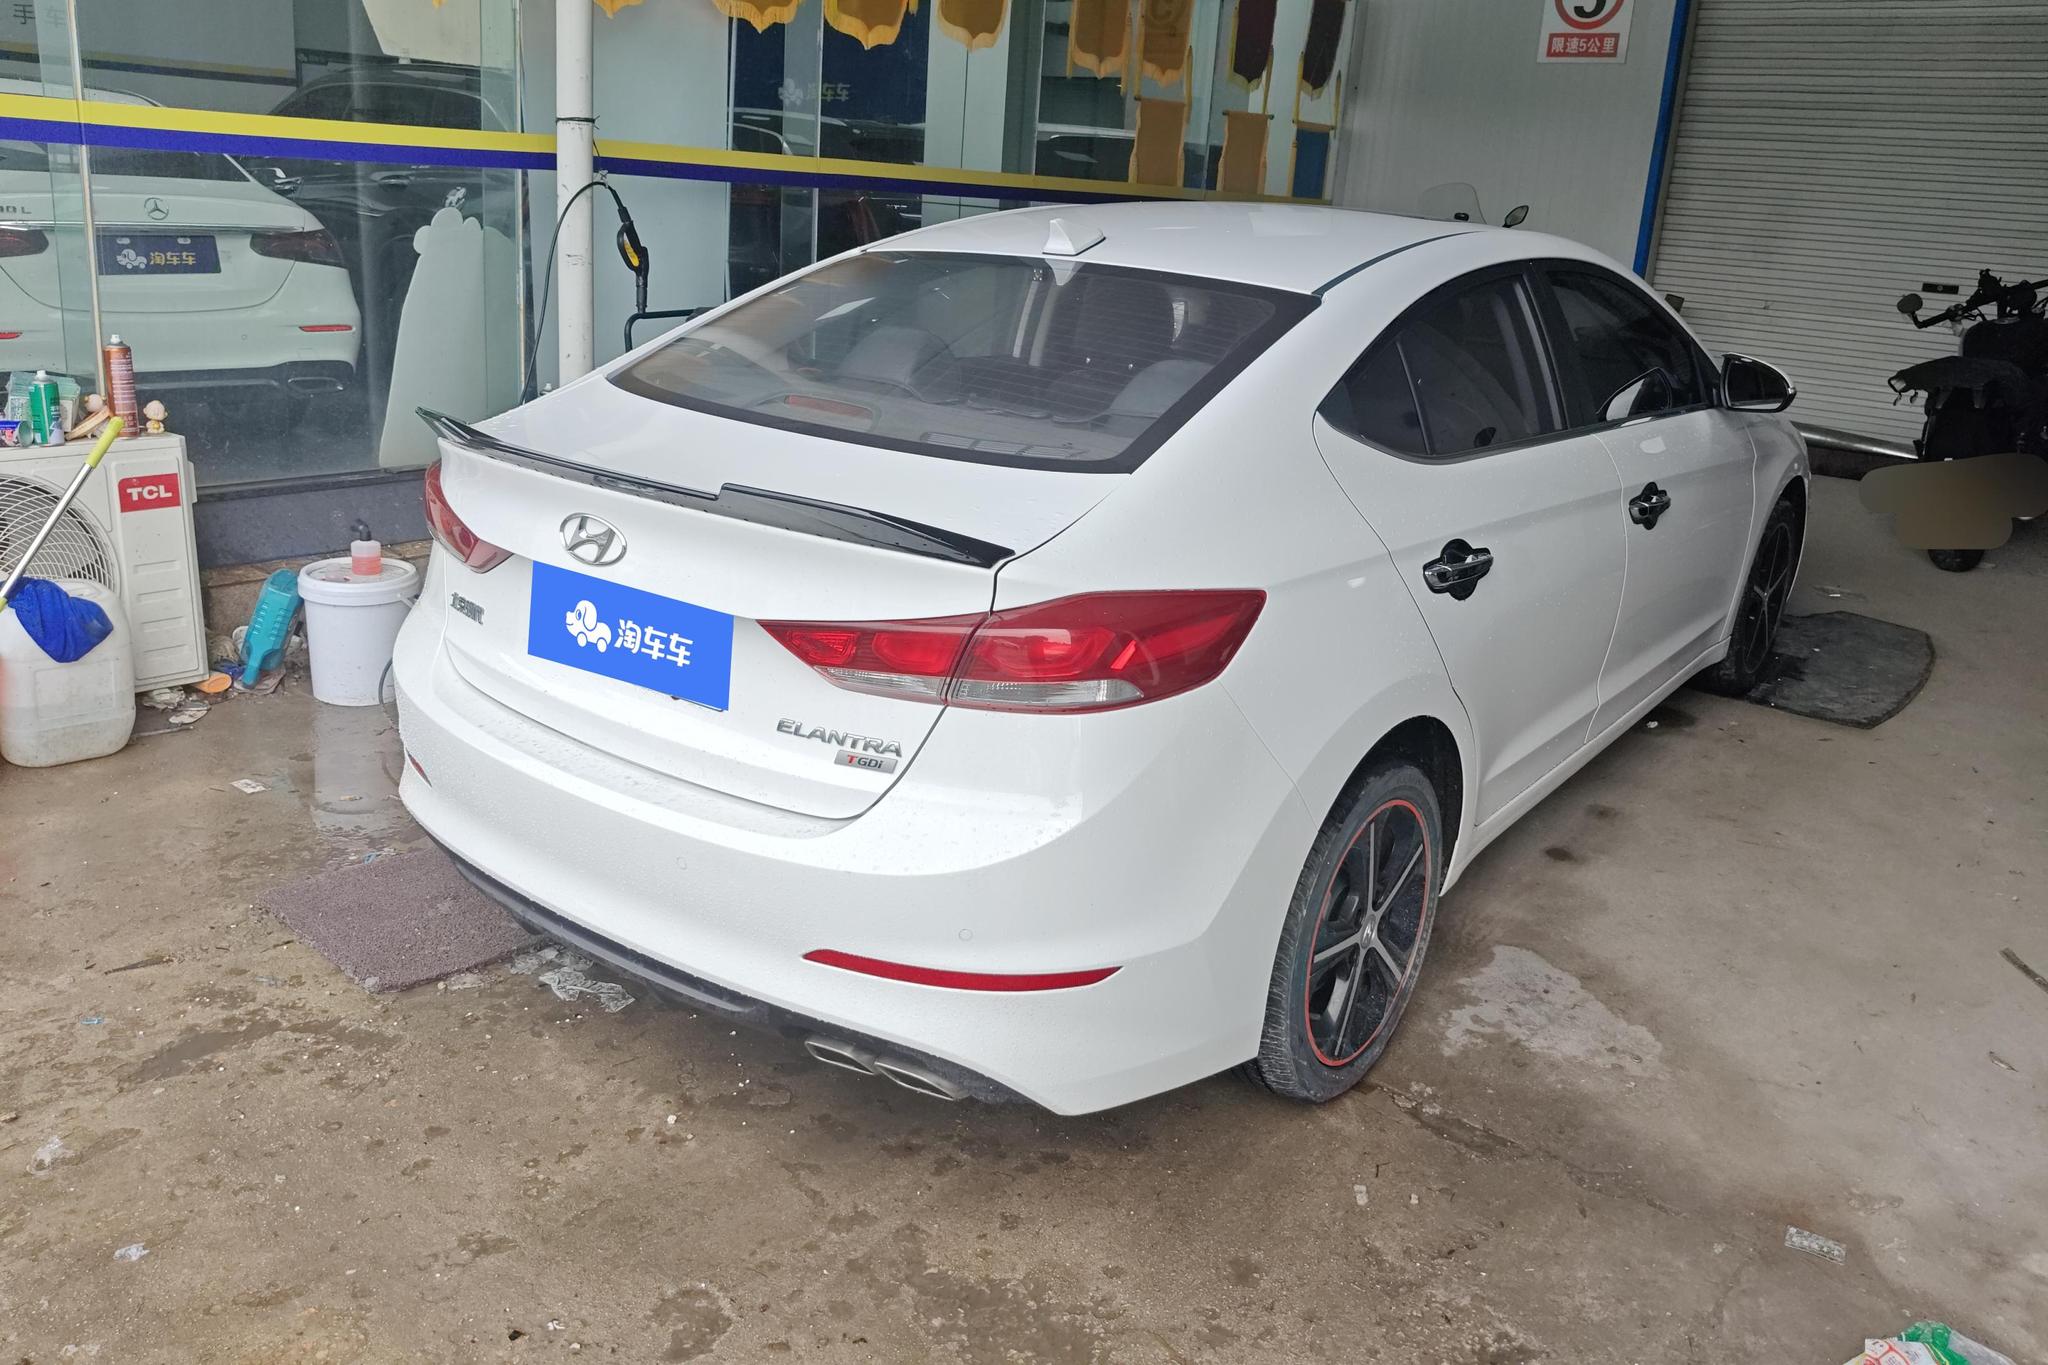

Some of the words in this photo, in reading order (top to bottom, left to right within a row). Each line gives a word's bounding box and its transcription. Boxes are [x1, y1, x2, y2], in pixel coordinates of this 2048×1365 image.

[1551, 37, 1615, 53] 限速5公里
[150, 251, 196, 266] 淘车车
[126, 485, 172, 501] TCL
[776, 717, 902, 757] ELANTRA
